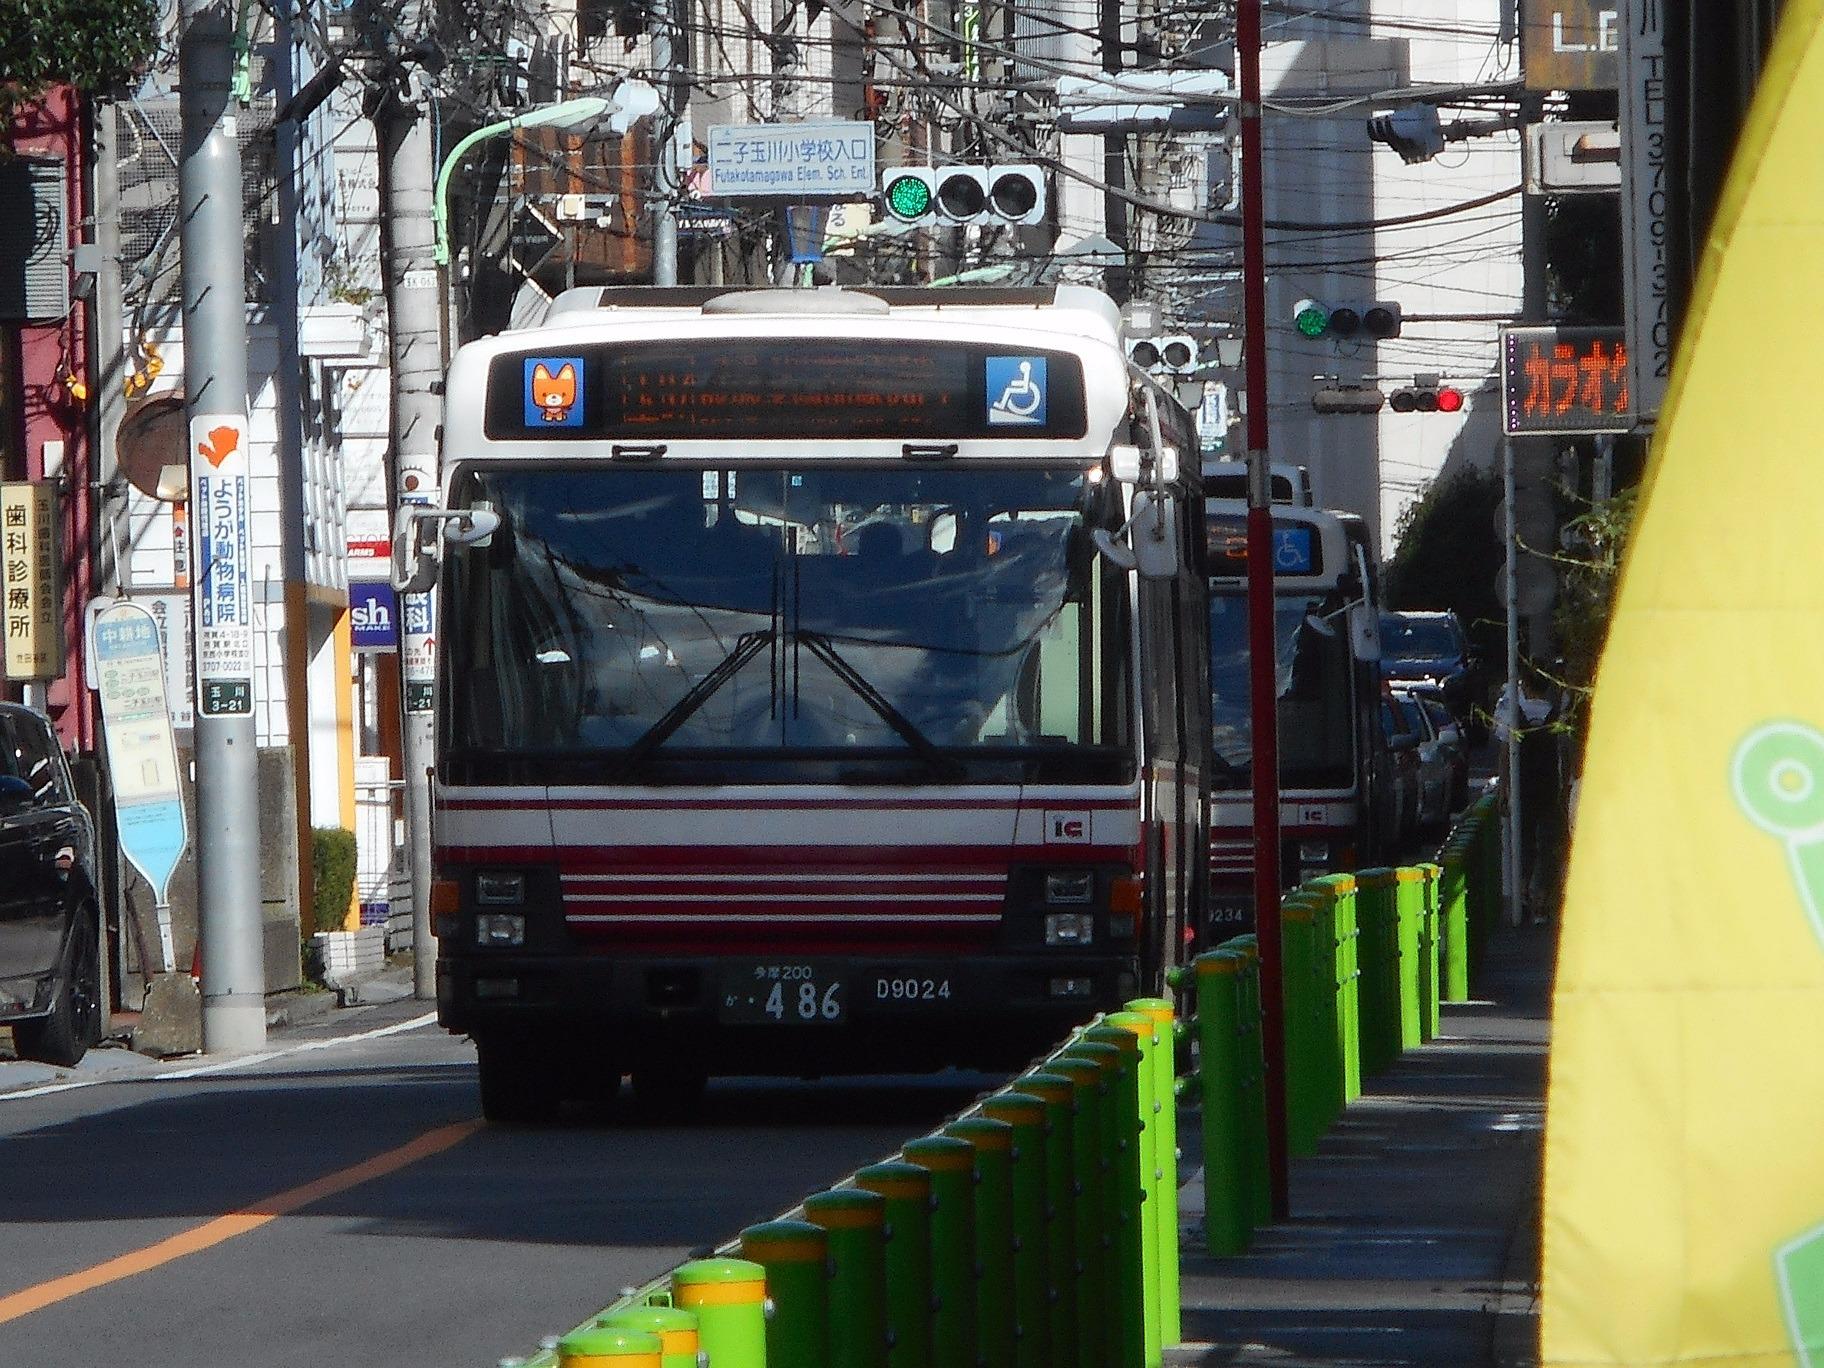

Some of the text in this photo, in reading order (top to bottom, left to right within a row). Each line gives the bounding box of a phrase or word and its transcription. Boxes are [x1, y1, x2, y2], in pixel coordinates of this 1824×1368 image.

[716, 139, 866, 164] 二子玉川小学校入口
[715, 168, 793, 185] Futakotamagawa
[213, 479, 236, 623] ようが動物病院
[6, 504, 30, 638] 歯科診療所
[212, 700, 243, 712] 3-21
[877, 979, 951, 999] D9024
